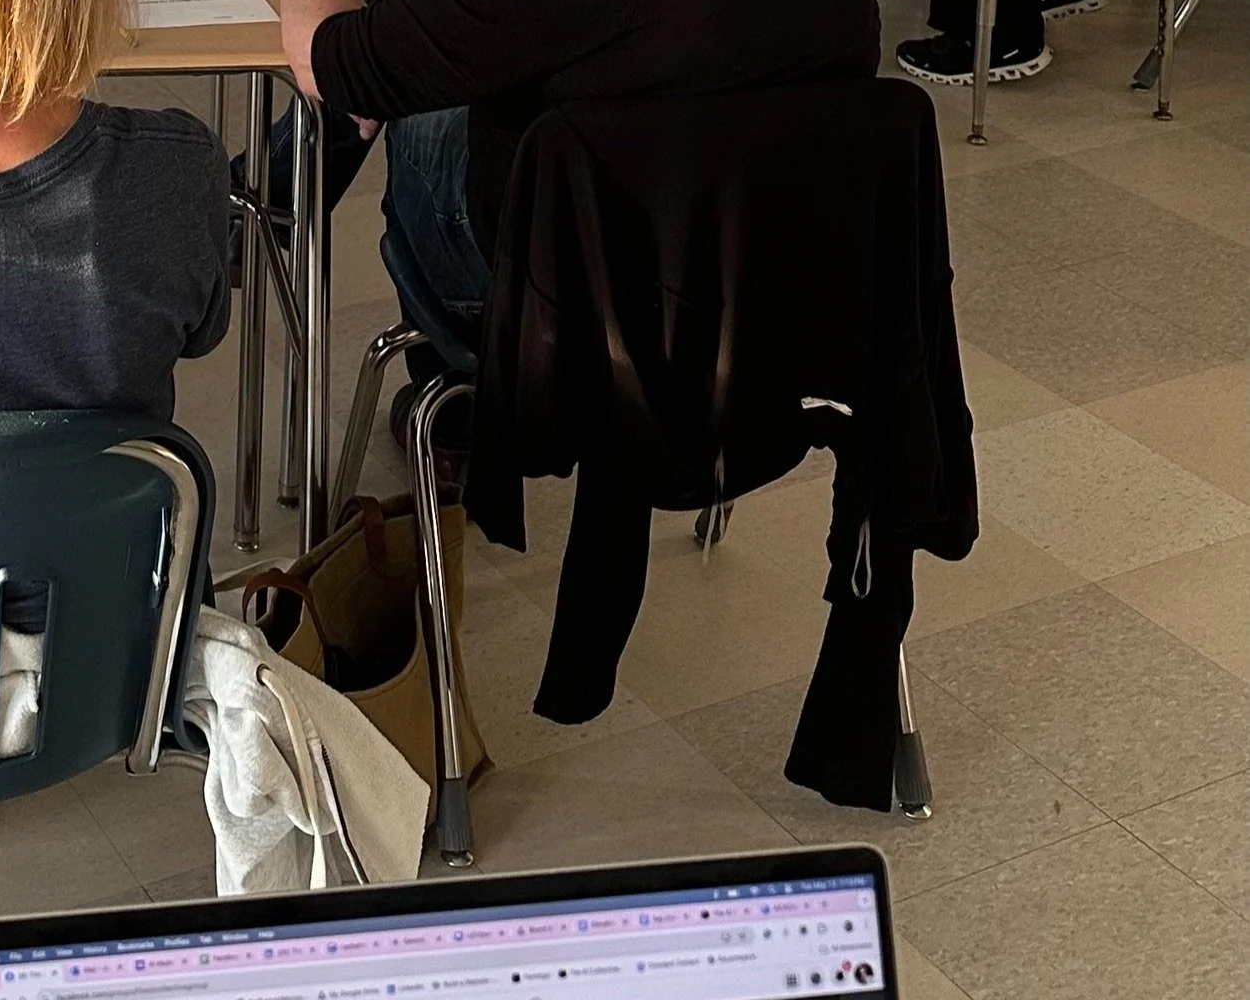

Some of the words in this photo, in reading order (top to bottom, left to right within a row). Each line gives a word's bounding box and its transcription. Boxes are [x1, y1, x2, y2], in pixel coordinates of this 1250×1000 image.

[32, 950, 46, 958] Edit
[56, 948, 73, 956] View
[83, 946, 107, 954] History
[200, 935, 212, 943] Tab
[222, 932, 249, 941] Window
[258, 930, 275, 938] Help
